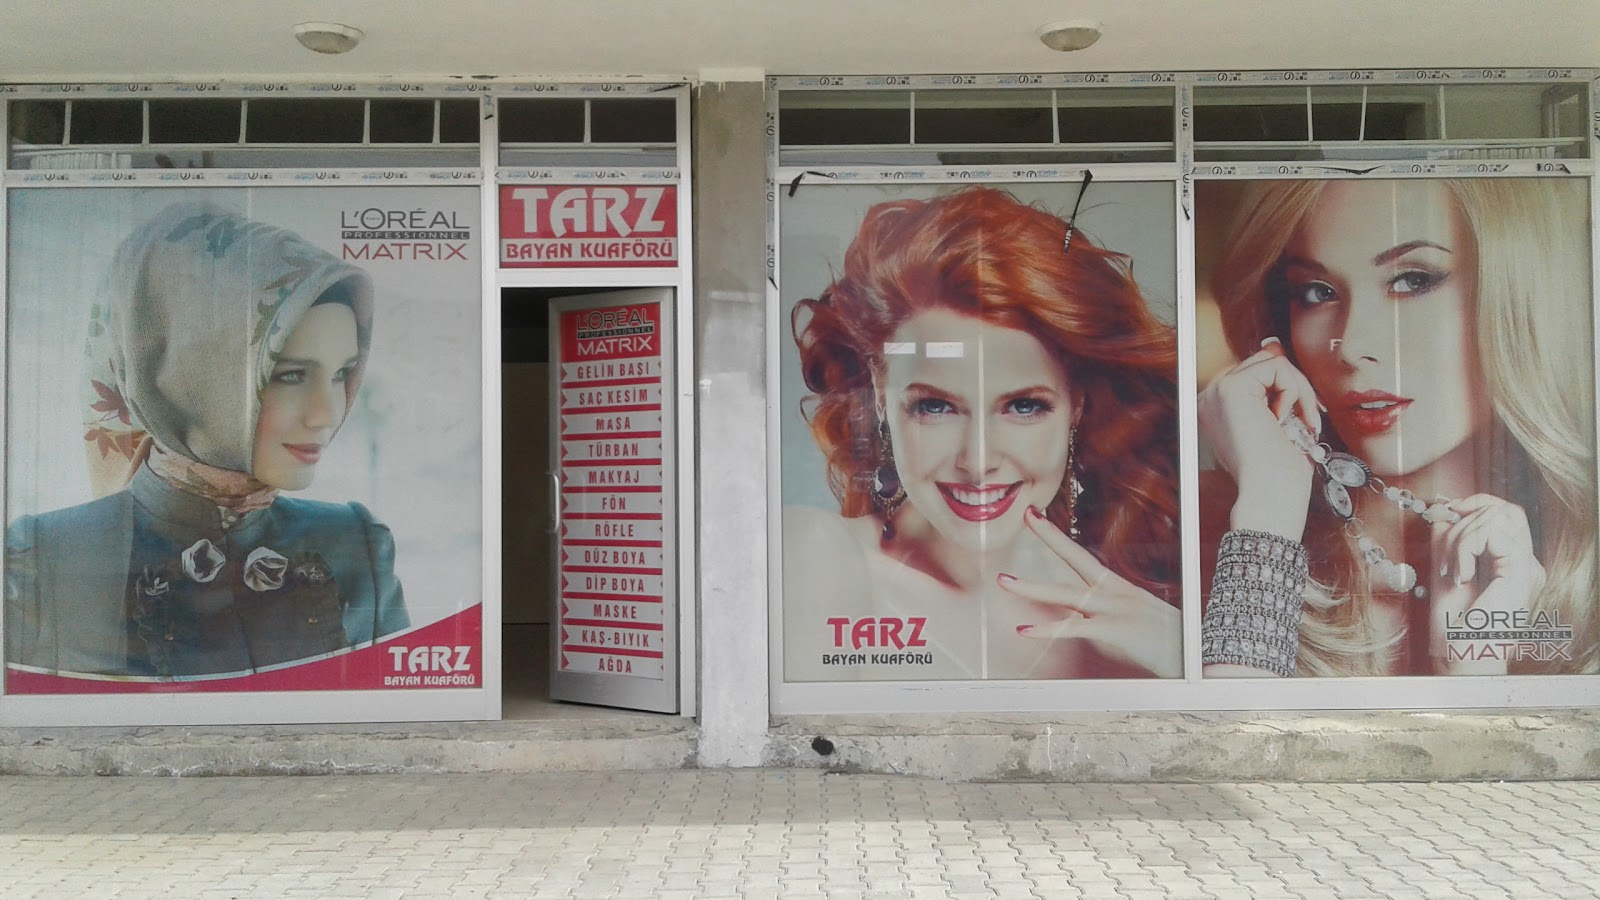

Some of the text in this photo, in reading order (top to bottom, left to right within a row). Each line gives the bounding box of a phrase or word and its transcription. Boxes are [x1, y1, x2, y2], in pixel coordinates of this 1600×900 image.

[341, 208, 470, 230] L'ORÉAL
[512, 187, 665, 238] TARZ
[343, 231, 469, 239] PROFESSIONNEL
[343, 243, 468, 260] MATRIX
[506, 239, 673, 260] BAYAN KUAFÖRÜ
[577, 307, 654, 332] L'ORÉAL
[578, 326, 654, 339] PROFESSIONNEL
[578, 336, 653, 356] MATRIX
[577, 361, 650, 380] GELİN BAŞI
[579, 386, 648, 405] SAÇ KESİM
[595, 416, 631, 432] MAŞA
[588, 442, 639, 458] TÜRBAN
[588, 469, 641, 484] MAKYAJ
[602, 496, 627, 511] FÖN
[595, 521, 635, 538] RÖFLE
[584, 548, 646, 565] DÜZ BOYA
[585, 576, 645, 592] DİP BOYA
[593, 604, 637, 619] MASKE
[1445, 608, 1572, 630] L'ORÉAL
[581, 630, 650, 648] KAŞ-BIYIK
[826, 617, 928, 651] TARZ
[1448, 631, 1571, 639] PROFESSIONNEL
[387, 645, 471, 673] TARZ
[822, 651, 933, 666] BAYAN KUAFÖRÜ
[1448, 642, 1572, 661] MATRIX
[598, 657, 633, 674] AĞDA
[384, 673, 476, 686] BAYAN KUAFÖRÜ
